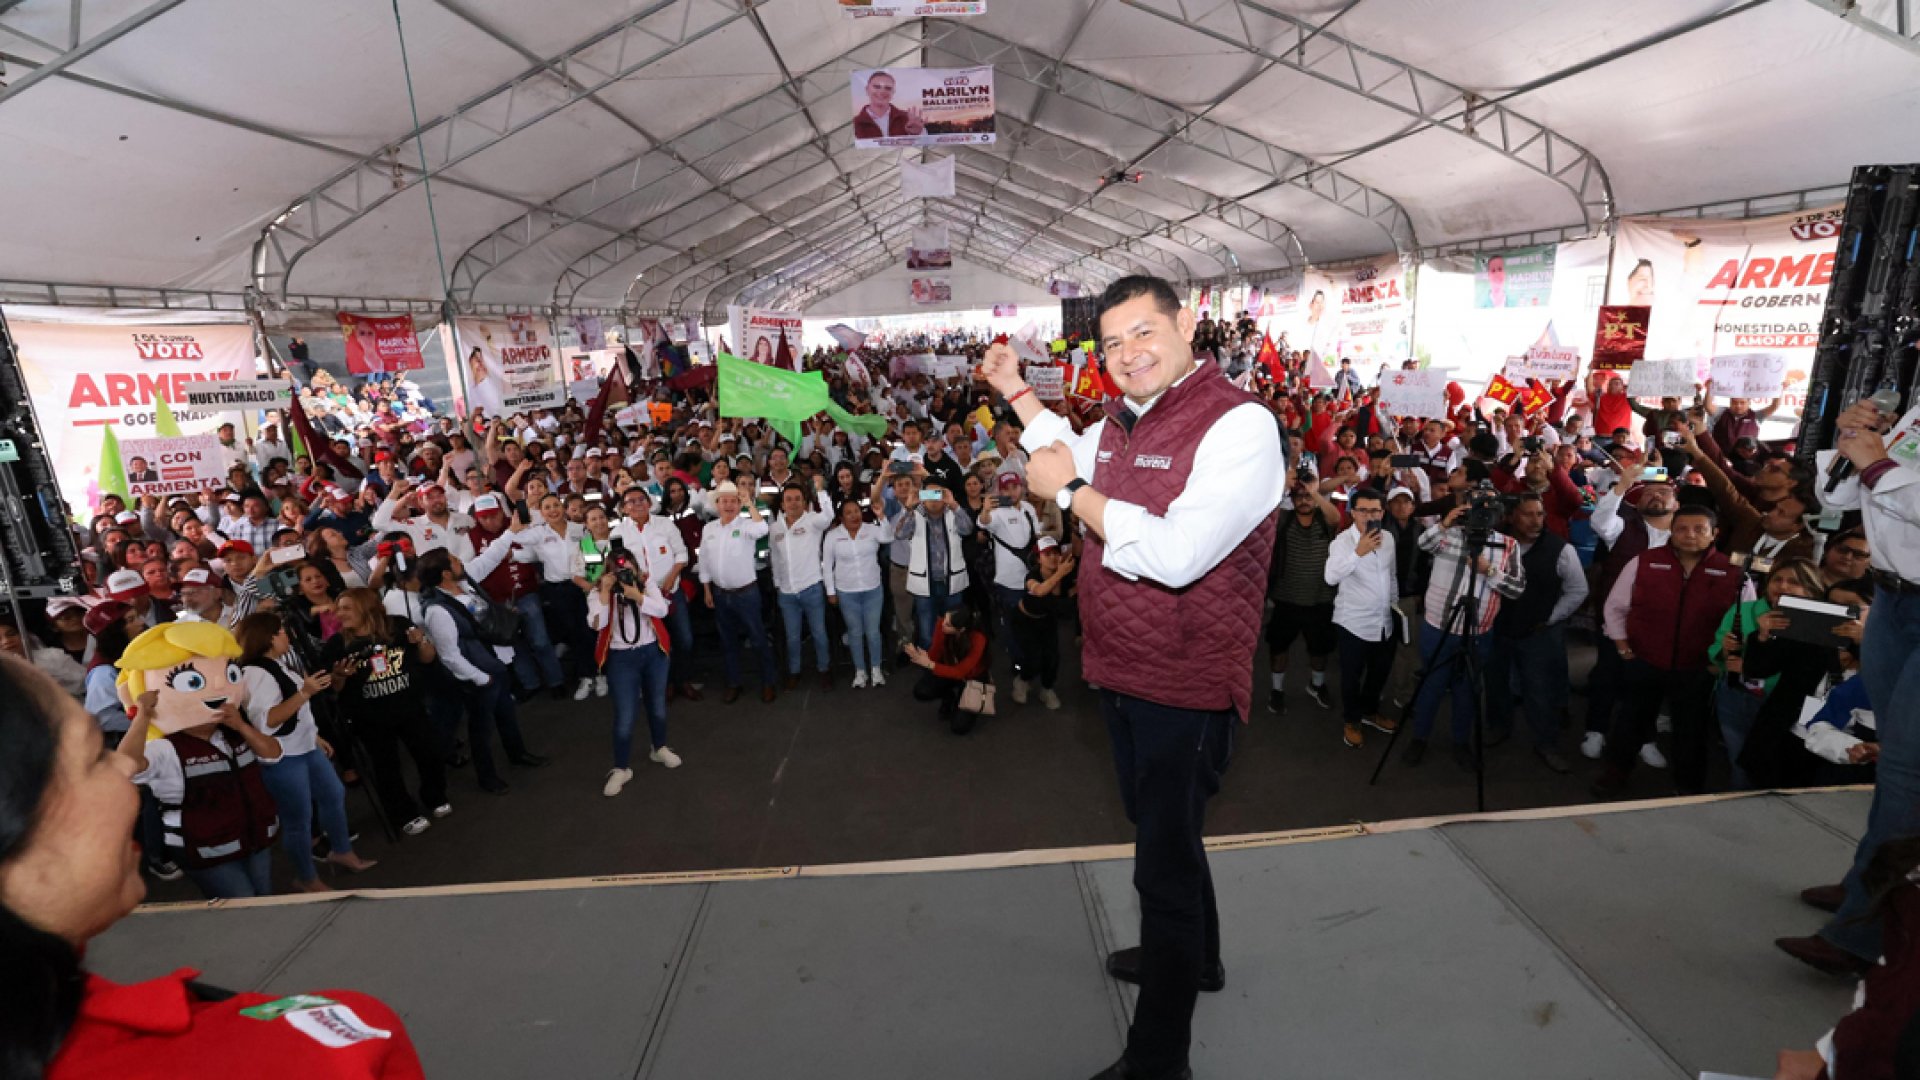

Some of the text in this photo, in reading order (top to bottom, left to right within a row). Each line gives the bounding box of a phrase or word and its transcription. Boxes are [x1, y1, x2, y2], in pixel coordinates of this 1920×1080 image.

[922, 85, 990, 99] MARILYN
[1604, 322, 1642, 339] PT
[1737, 335, 1784, 347] AMOR
[1787, 335, 1798, 346] A
[138, 343, 203, 358] VOTA
[188, 390, 275, 405] HUEYTAMALCO
[1487, 382, 1515, 402] PT
[160, 451, 202, 464] CON
[130, 477, 222, 495] ARMENTA
[362, 673, 410, 699] SUNDAY
